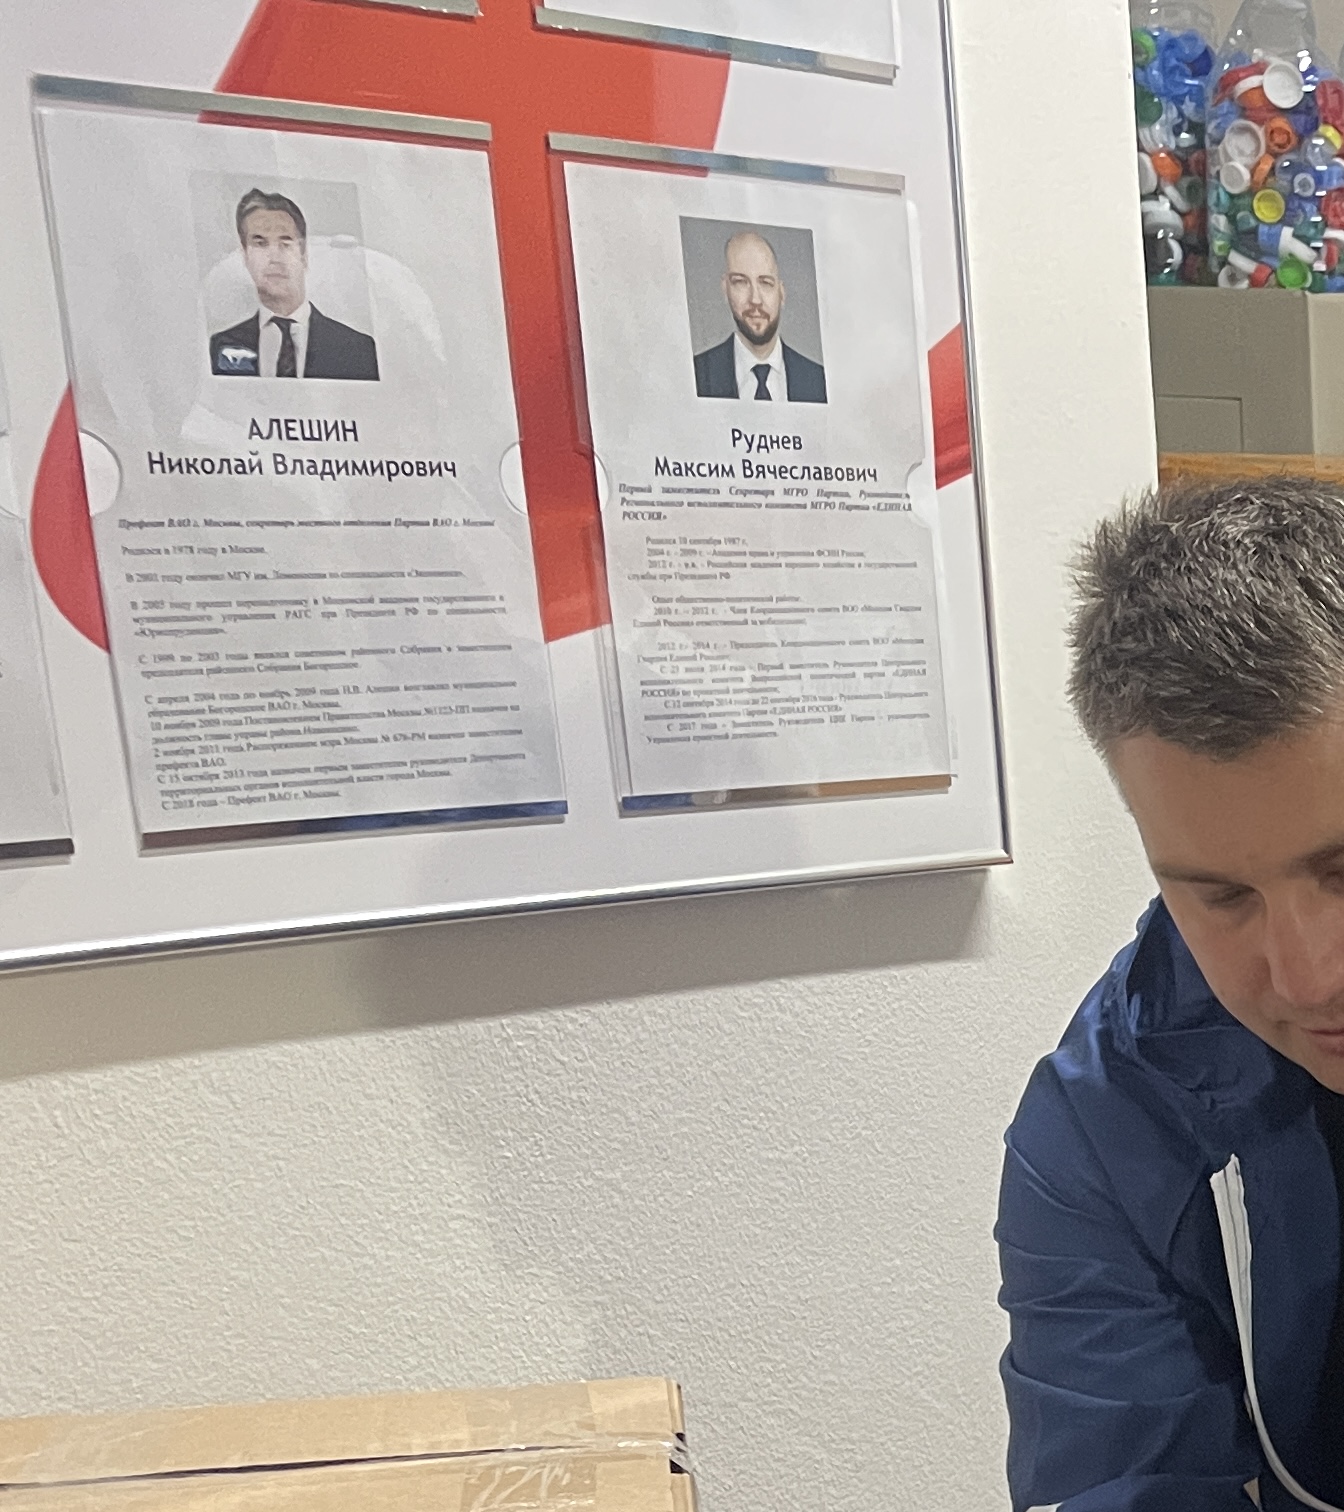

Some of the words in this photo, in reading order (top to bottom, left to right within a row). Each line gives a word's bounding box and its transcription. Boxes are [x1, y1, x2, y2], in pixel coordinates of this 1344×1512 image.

[248, 417, 359, 443] АЛЕШИН
[731, 428, 803, 452] Руднев
[147, 451, 262, 476] Николай
[273, 453, 457, 481] Владимирович
[654, 457, 734, 479] Максим
[741, 459, 878, 483] Вячеславович
